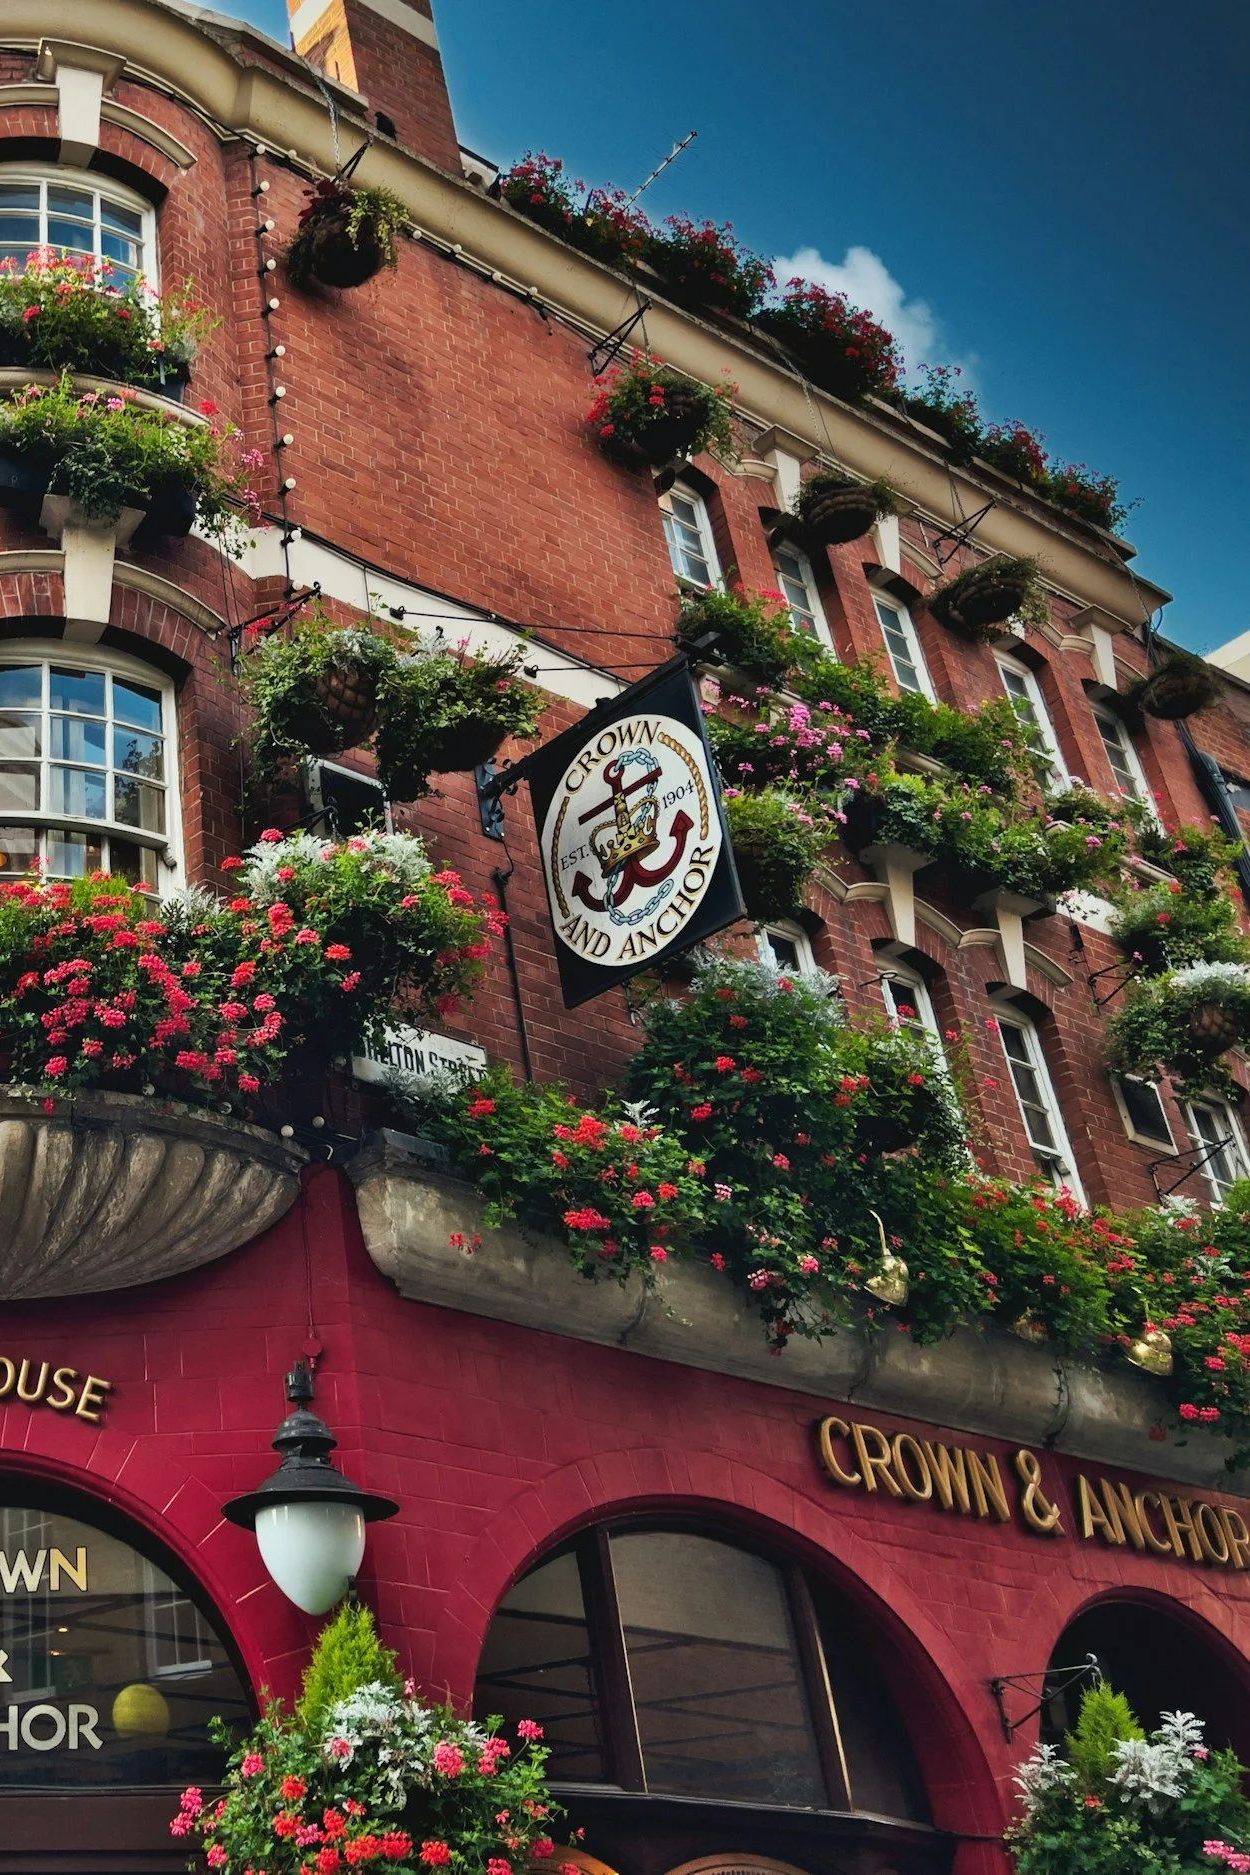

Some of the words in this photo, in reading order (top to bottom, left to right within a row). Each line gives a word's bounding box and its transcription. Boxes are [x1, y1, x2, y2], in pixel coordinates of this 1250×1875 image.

[565, 720, 661, 796] CROWN
[560, 843, 592, 872] EST.
[661, 779, 695, 810] 1904
[559, 913, 612, 962] AND
[618, 845, 715, 961] ANCHOR
[819, 1416, 1011, 1523] CROWN
[1015, 1449, 1067, 1537] &
[1077, 1474, 1250, 1569] ANCHOR
